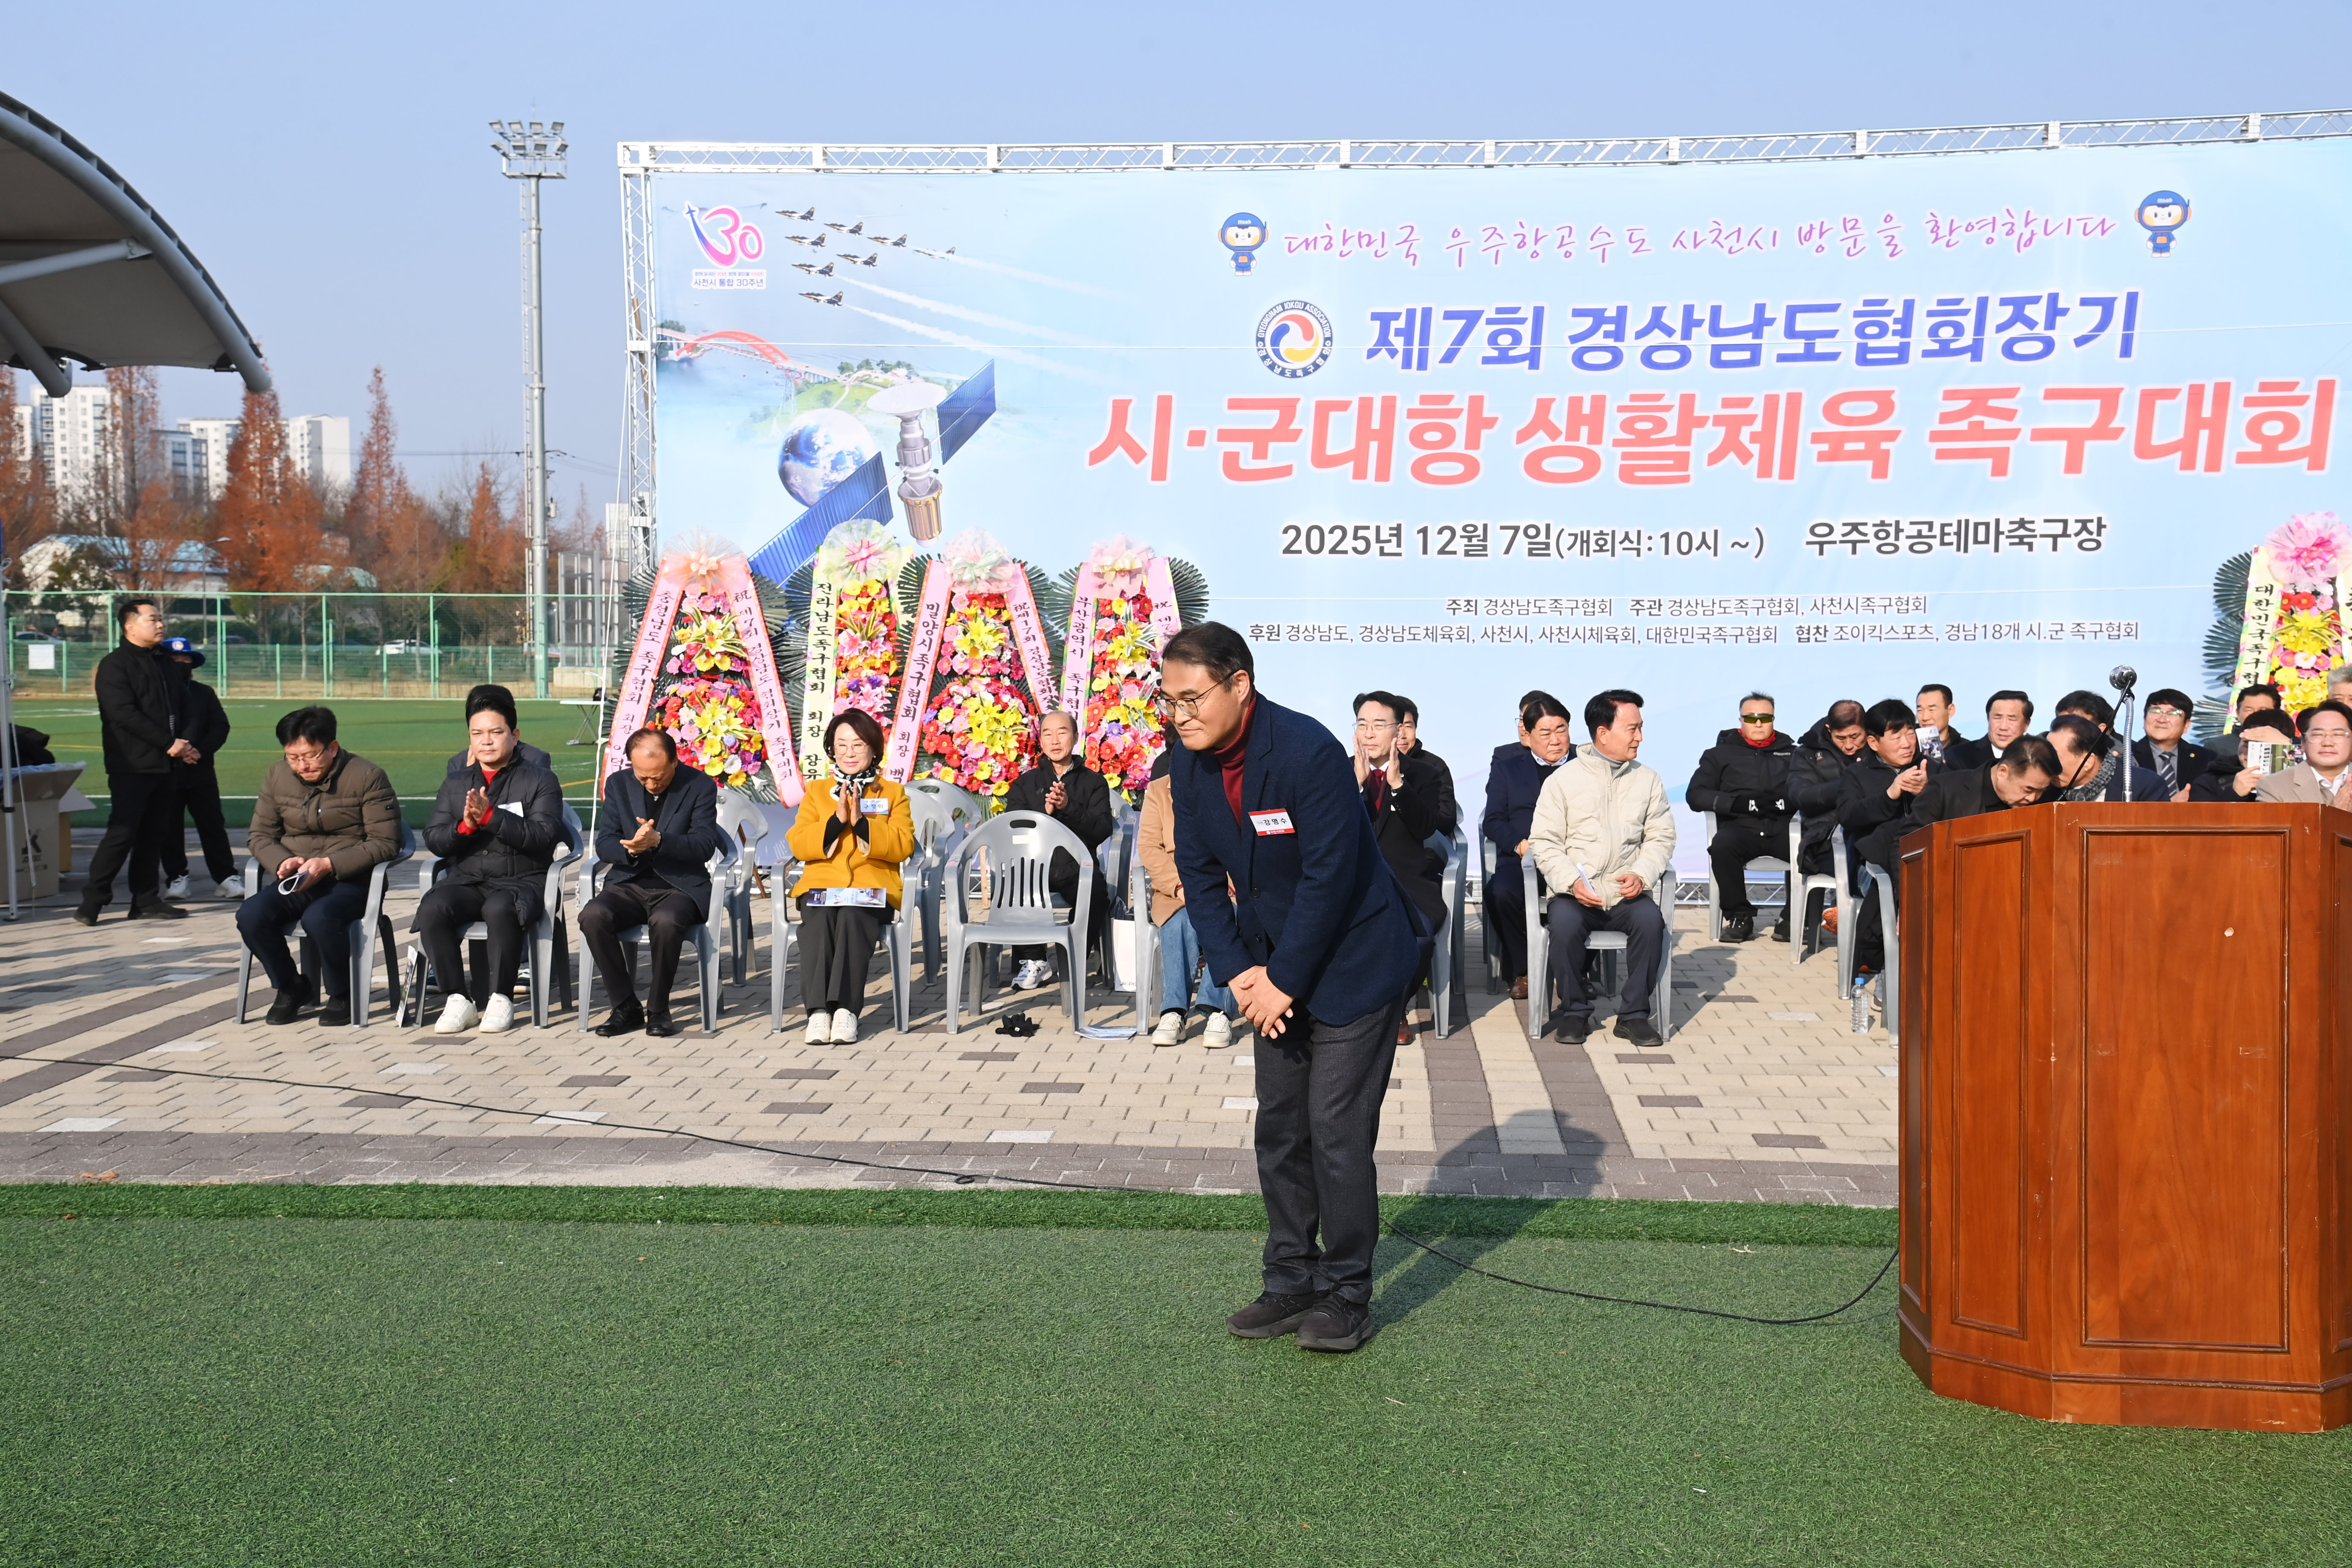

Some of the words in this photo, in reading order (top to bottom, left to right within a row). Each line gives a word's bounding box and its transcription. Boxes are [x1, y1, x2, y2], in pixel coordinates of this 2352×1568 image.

[1284, 223, 1421, 266] 대한민국
[1446, 221, 1652, 267] 우주항공수도
[1673, 221, 1777, 254] 사천시
[1799, 214, 1902, 258] 방문을
[1926, 209, 2115, 253] 환영합니다
[694, 279, 716, 287] 사천시
[719, 279, 734, 287] 통합
[737, 279, 763, 287] 30주년
[1257, 305, 1283, 338] GYEONGNAM
[1283, 301, 1304, 310] JOKGU
[1304, 304, 1331, 338] ASSOCIATION
[1367, 306, 1544, 370] 제7회
[1569, 292, 2139, 371] 경상남도협회장기
[1516, 390, 1902, 485] 생활체육
[1930, 380, 2336, 476] 족구대회
[1282, 523, 1403, 557] 2025년
[1416, 523, 1489, 557] 12월
[1805, 516, 2107, 556] 우주항공테마축구장
[643, 590, 675, 644] 충청남도
[733, 590, 752, 602] 祝
[1446, 599, 1478, 616] 주최
[1484, 599, 1612, 616] 경상남도족구협회
[1629, 599, 1663, 616] 주관
[1668, 598, 1805, 616] 경상남도족구협회,
[1810, 596, 1927, 615] 사천시족구협회
[808, 582, 834, 694] 전라남도족구협회
[1069, 596, 1092, 659] 부산광역시
[1249, 624, 1281, 641] 후원
[1285, 624, 1353, 643] 경상남도,
[1358, 625, 1475, 644] 경상남도체육회,
[1480, 625, 1533, 644] 사천시,
[1538, 626, 1641, 645] 사천시체육회,
[1646, 626, 1777, 644] 대한민국족구협회
[1795, 625, 1829, 643] 협찬
[1833, 623, 1939, 642] 조이킥스포츠,
[1945, 623, 2020, 641] 경남18개
[2070, 622, 2139, 640] 족구협회
[2241, 583, 2274, 685] 대한민국족구협
[625, 651, 656, 705] 족구협회
[748, 642, 773, 686] 경상남도
[901, 602, 940, 722] 밀양시족구협회
[620, 713, 634, 734] 회장
[760, 688, 781, 730] 협회장기
[807, 710, 825, 738] 회장
[770, 736, 792, 781] 족구대회
[896, 731, 910, 757] 회장
[1263, 818, 1287, 826] 강명수
